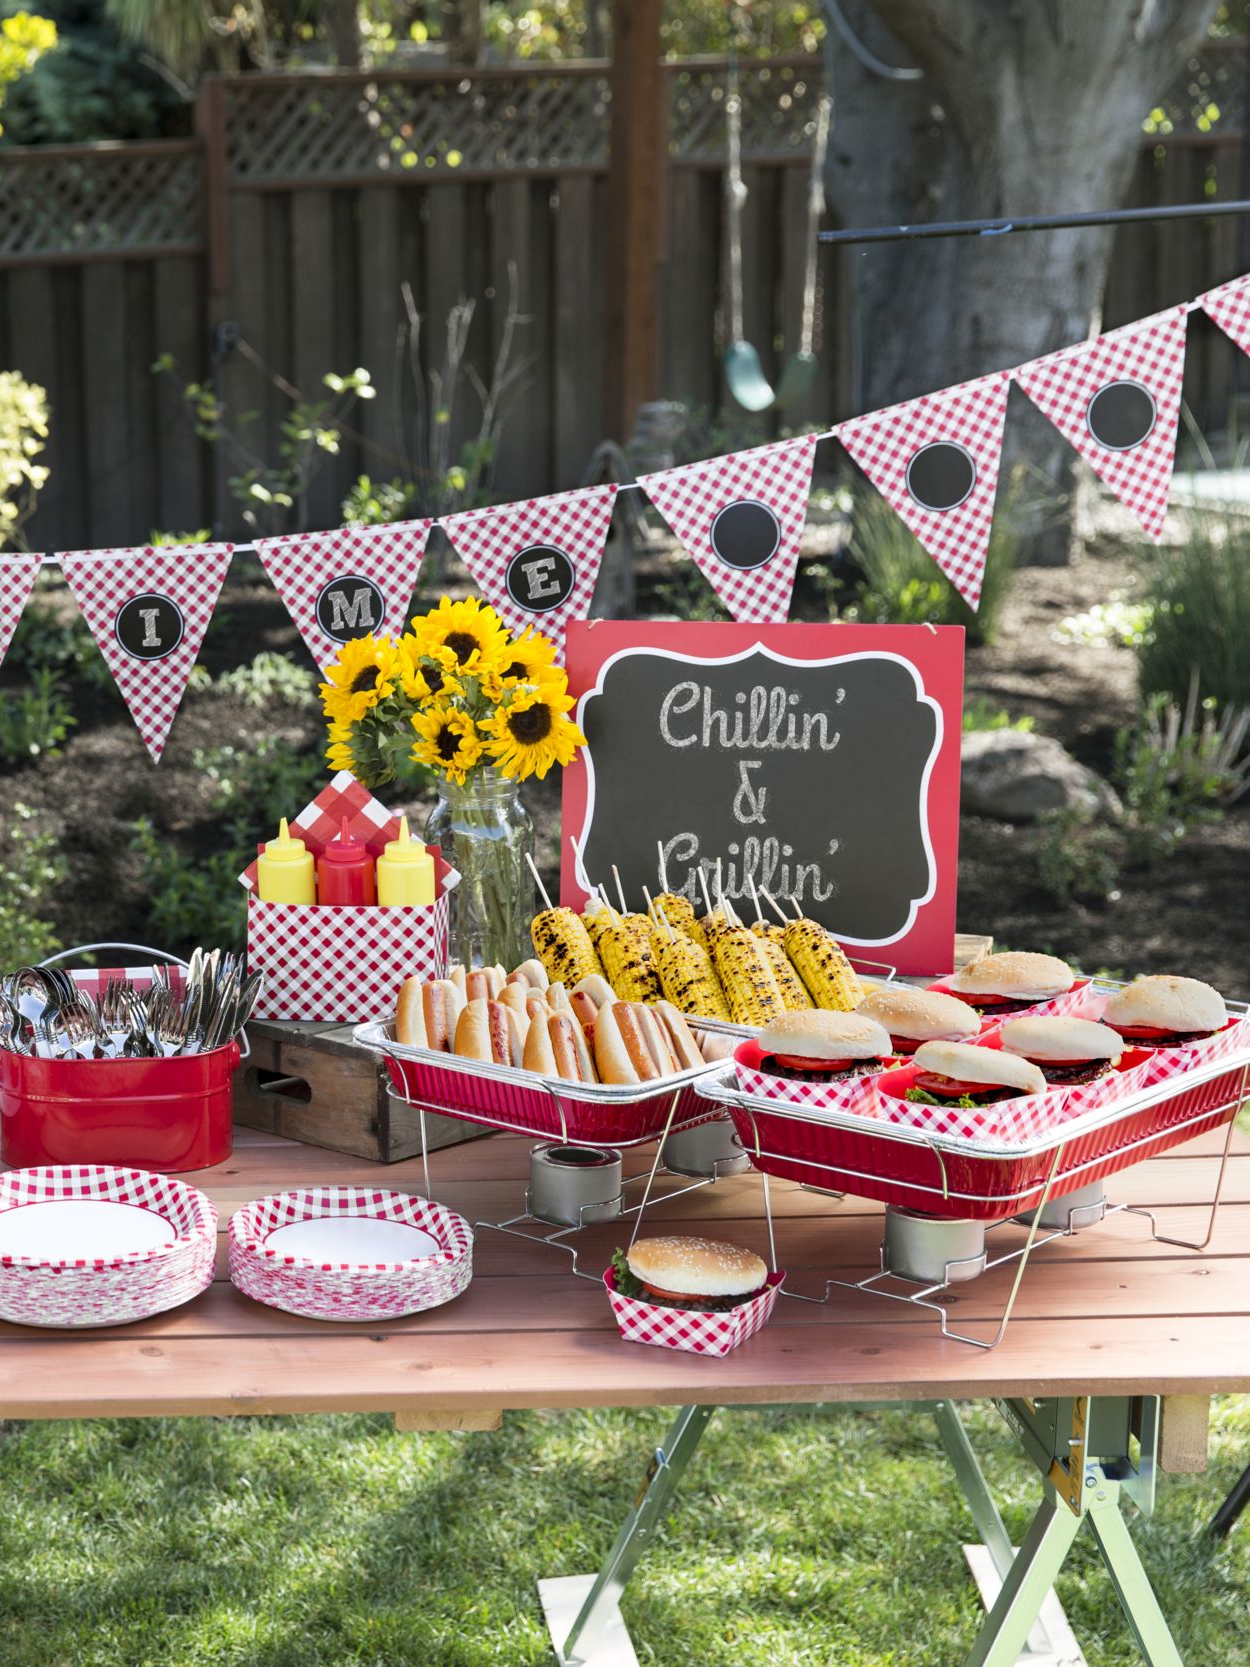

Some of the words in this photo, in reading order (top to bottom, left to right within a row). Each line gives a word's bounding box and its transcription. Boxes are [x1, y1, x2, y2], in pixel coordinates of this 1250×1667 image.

[139, 609, 161, 648] I
[327, 588, 375, 630] M
[522, 557, 561, 600] E
[658, 681, 846, 751] Chillin'
[732, 760, 767, 824] &
